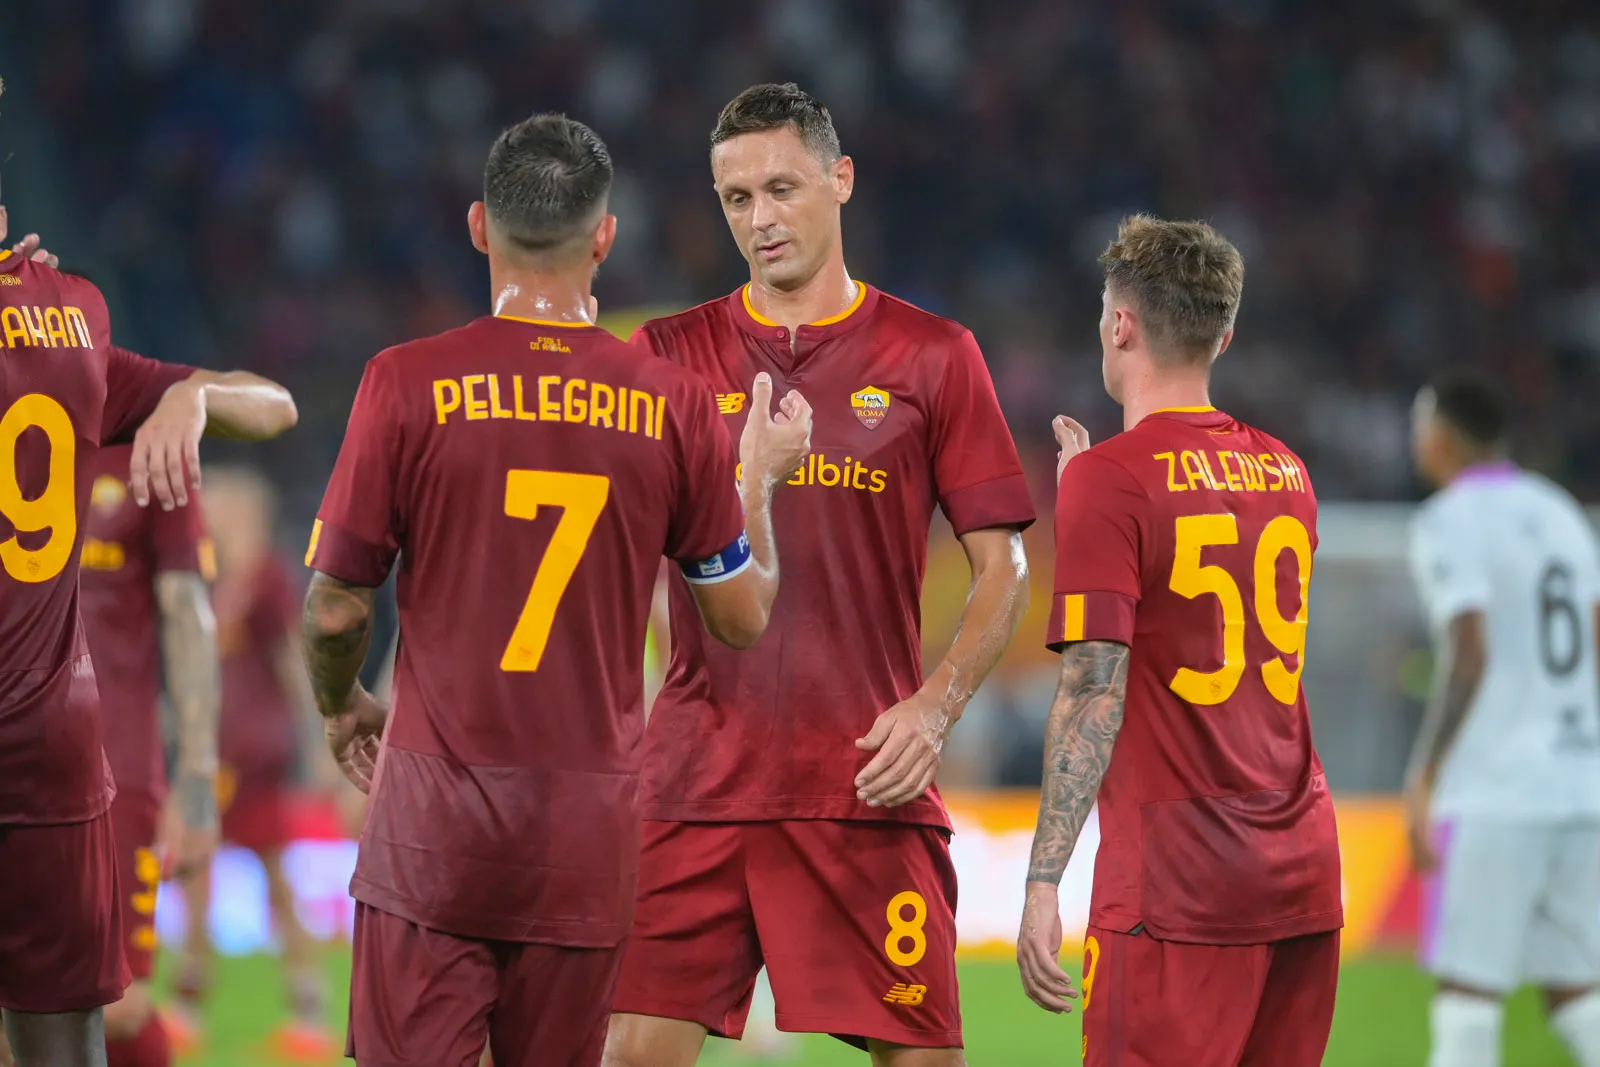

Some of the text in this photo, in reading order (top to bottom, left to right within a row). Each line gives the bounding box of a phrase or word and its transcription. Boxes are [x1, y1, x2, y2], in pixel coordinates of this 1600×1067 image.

[0, 306, 94, 350] AHAM
[432, 374, 666, 441] PELLEGRINI
[857, 409, 885, 417] ROMA
[0, 393, 76, 583] 9
[1153, 449, 1306, 494] ZALEWSKI
[499, 469, 610, 672] 7
[1168, 512, 1313, 706] 59
[1538, 560, 1583, 679] 6
[884, 890, 928, 967] 8
